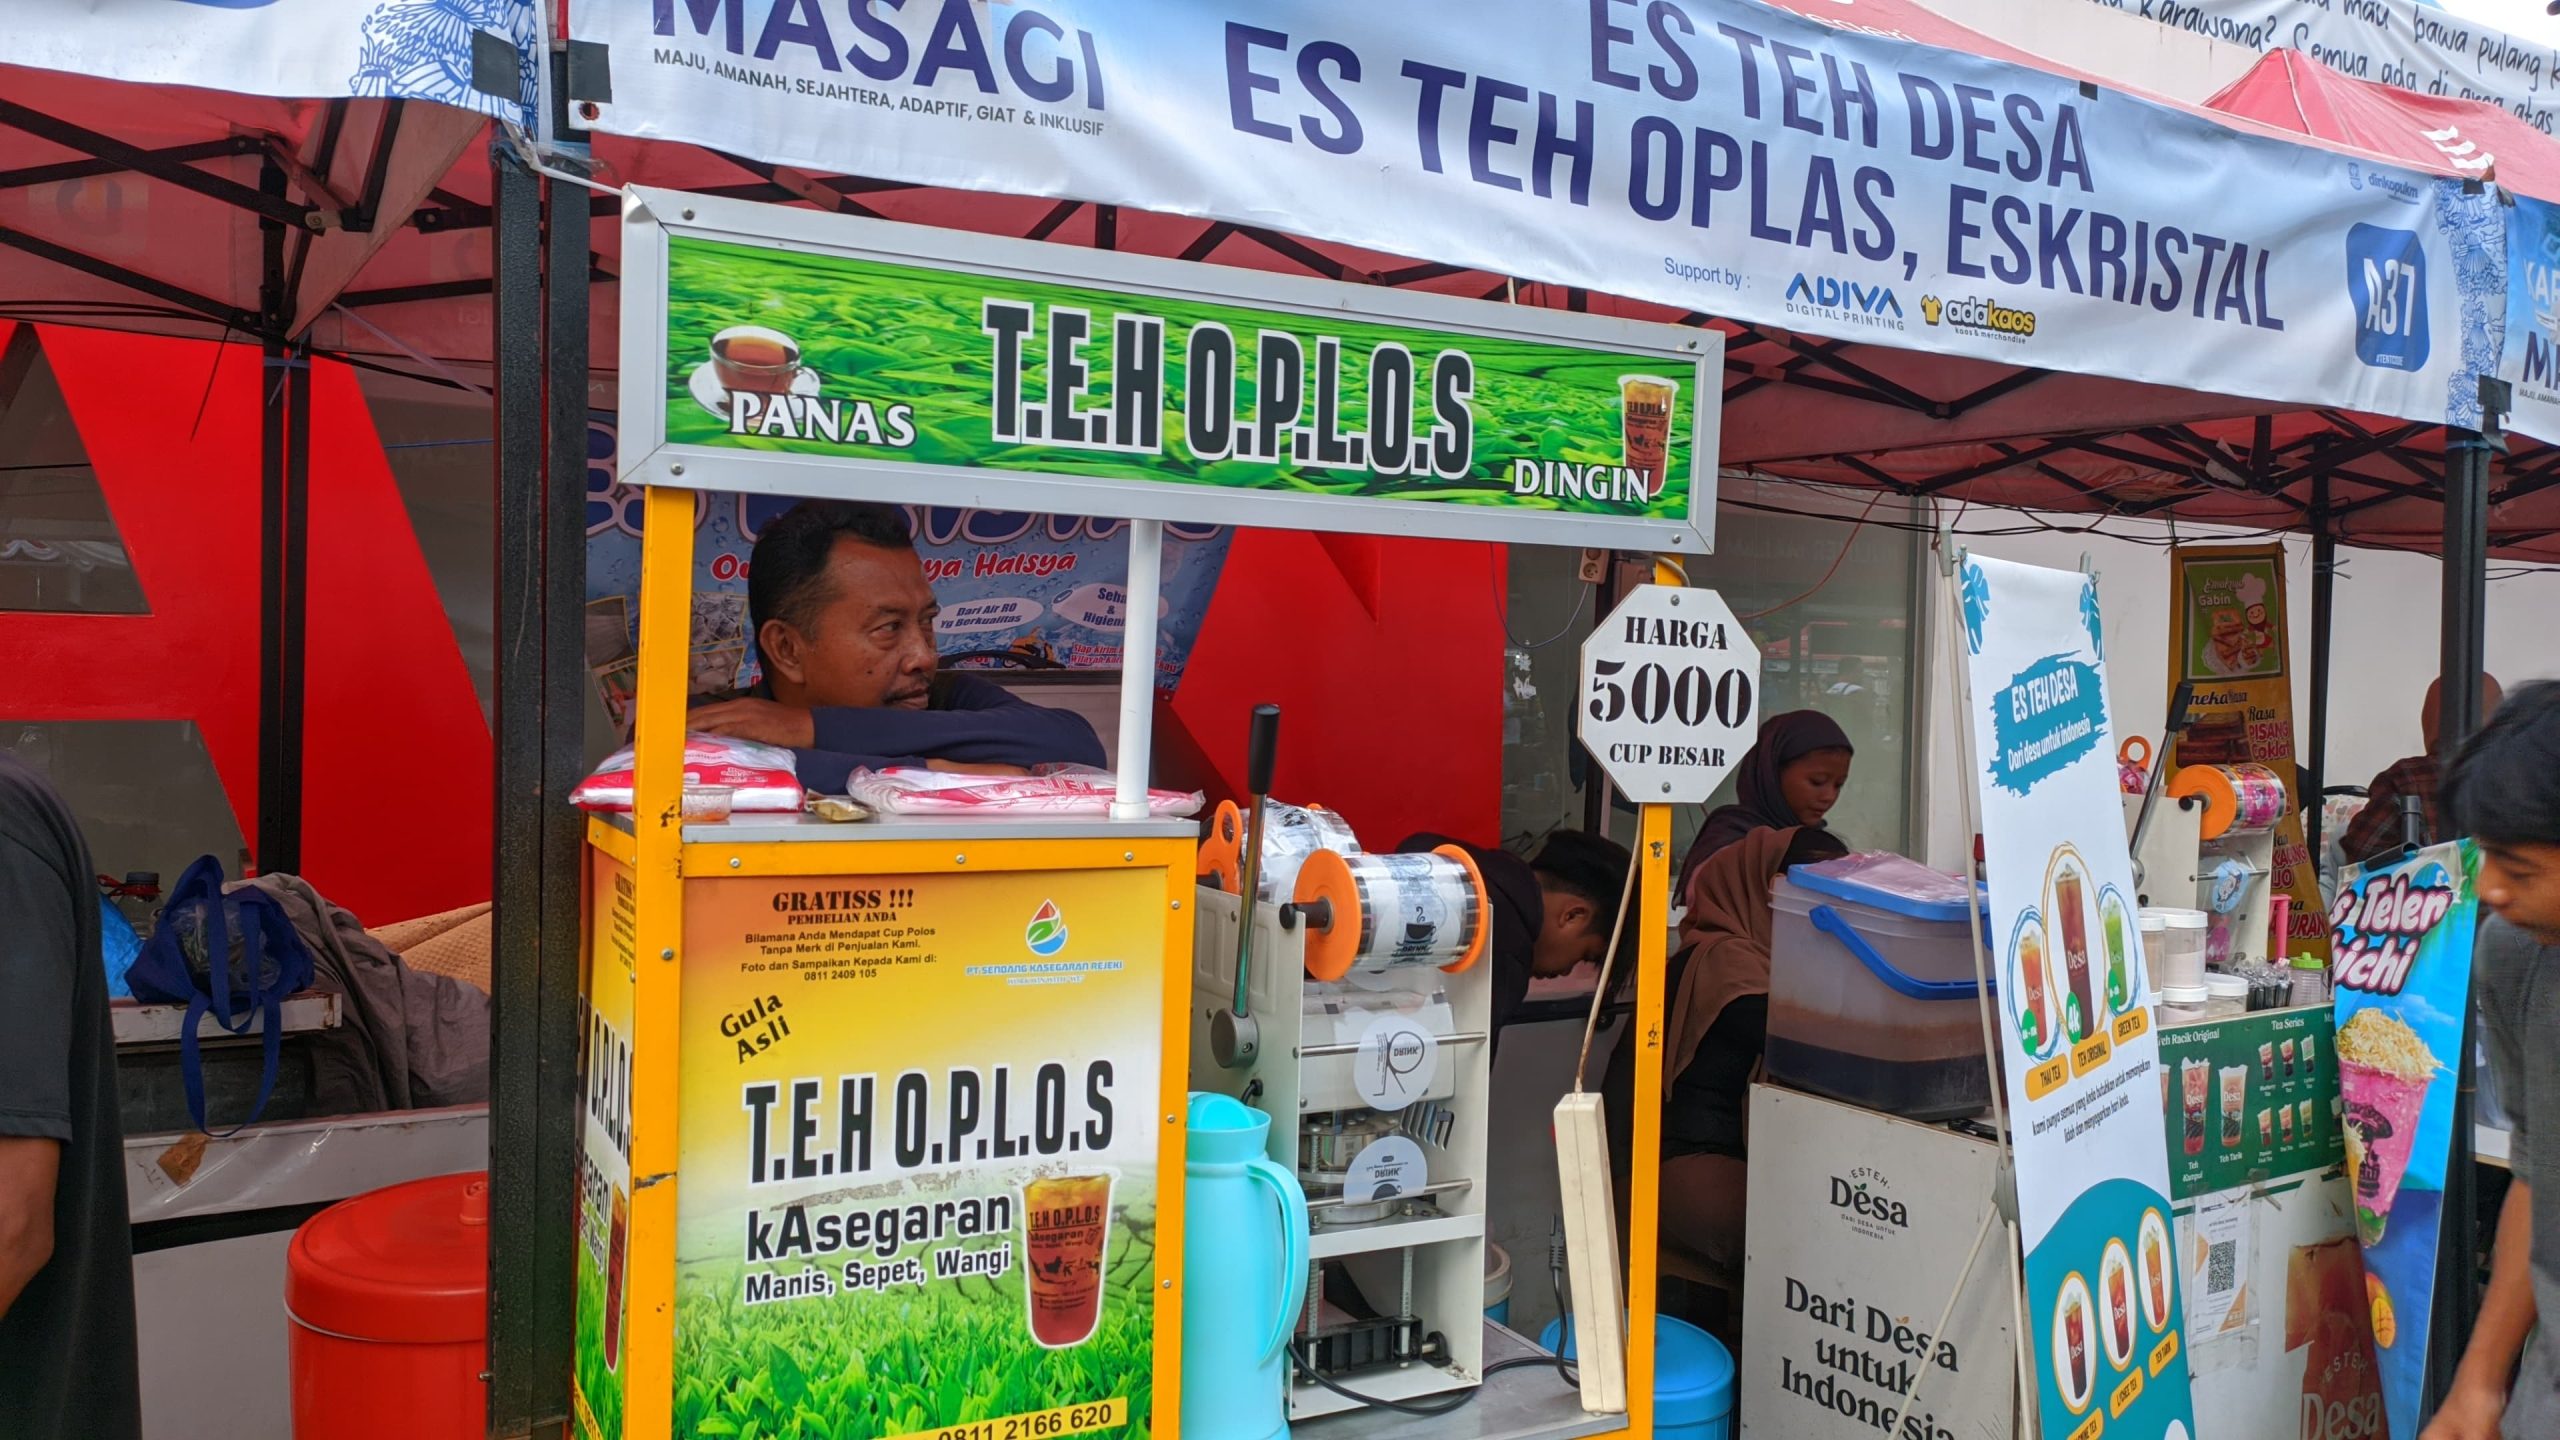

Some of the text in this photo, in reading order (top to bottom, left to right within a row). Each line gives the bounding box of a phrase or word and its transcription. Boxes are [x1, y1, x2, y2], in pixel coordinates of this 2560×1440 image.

[653, 0, 1105, 111] MASAGI
[2413, 4, 2468, 52] bawa
[2476, 33, 2542, 93] pulang
[654, 48, 1105, 137] MAJU, AMANAH, SEJAHTERA, ADAPTIF, GIAT & INKLUSIF
[1589, 0, 2095, 193] ES TEH DESA
[1225, 20, 2285, 332] ES TEH OPLAS, ESKRISTAL
[1664, 256, 1722, 285] Support
[1725, 268, 1742, 291] by
[1785, 272, 1904, 319] ADIVA
[2364, 258, 2416, 337] A37
[1785, 302, 1905, 333] DIGITAL PRINTING
[1946, 296, 2036, 337] adakaos
[983, 299, 1474, 479] T.E.H O.P.L.O.S
[726, 390, 916, 448] PANAS
[1513, 458, 1650, 505] DINGIN
[982, 604, 1000, 615] Air
[1097, 587, 1127, 605] Seha
[1624, 614, 1729, 652] HARGA
[1588, 658, 1754, 730] 5000
[2011, 665, 2079, 724] ES TEH DESA
[2189, 690, 2228, 706] neka
[1608, 743, 1726, 768] CUP BESAR
[772, 888, 915, 913] GRATISS !!!
[787, 911, 897, 926] PEMBELIAN ANDA
[745, 926, 937, 944] Bilamana Anda Mendapat Cup Polos
[760, 945, 793, 956] Tanpa
[795, 943, 822, 954] Merk
[824, 942, 835, 952] di
[837, 941, 889, 953] Penjualan
[741, 962, 766, 973] Foto
[769, 961, 789, 971] dan
[792, 958, 851, 970] Sampaikan
[853, 956, 893, 968] Kepada
[895, 954, 922, 965] Kami
[803, 969, 877, 982] 0811 2409 105
[719, 991, 784, 1042] Gula
[735, 1014, 792, 1065] Asli
[743, 1059, 1115, 1185] T.E.H O.P.L.O.S
[1829, 1175, 1909, 1228] Desa
[745, 1194, 1011, 1262] kAsegaran
[745, 1242, 1010, 1304] Manis, Sepet, Wangi
[1784, 1275, 1960, 1373] Dari Desa
[1815, 1338, 1921, 1401] untuk
[1004, 1411, 1062, 1440] 2166
[1070, 1404, 1112, 1430] 620
[2302, 1392, 2381, 1440] Desa
